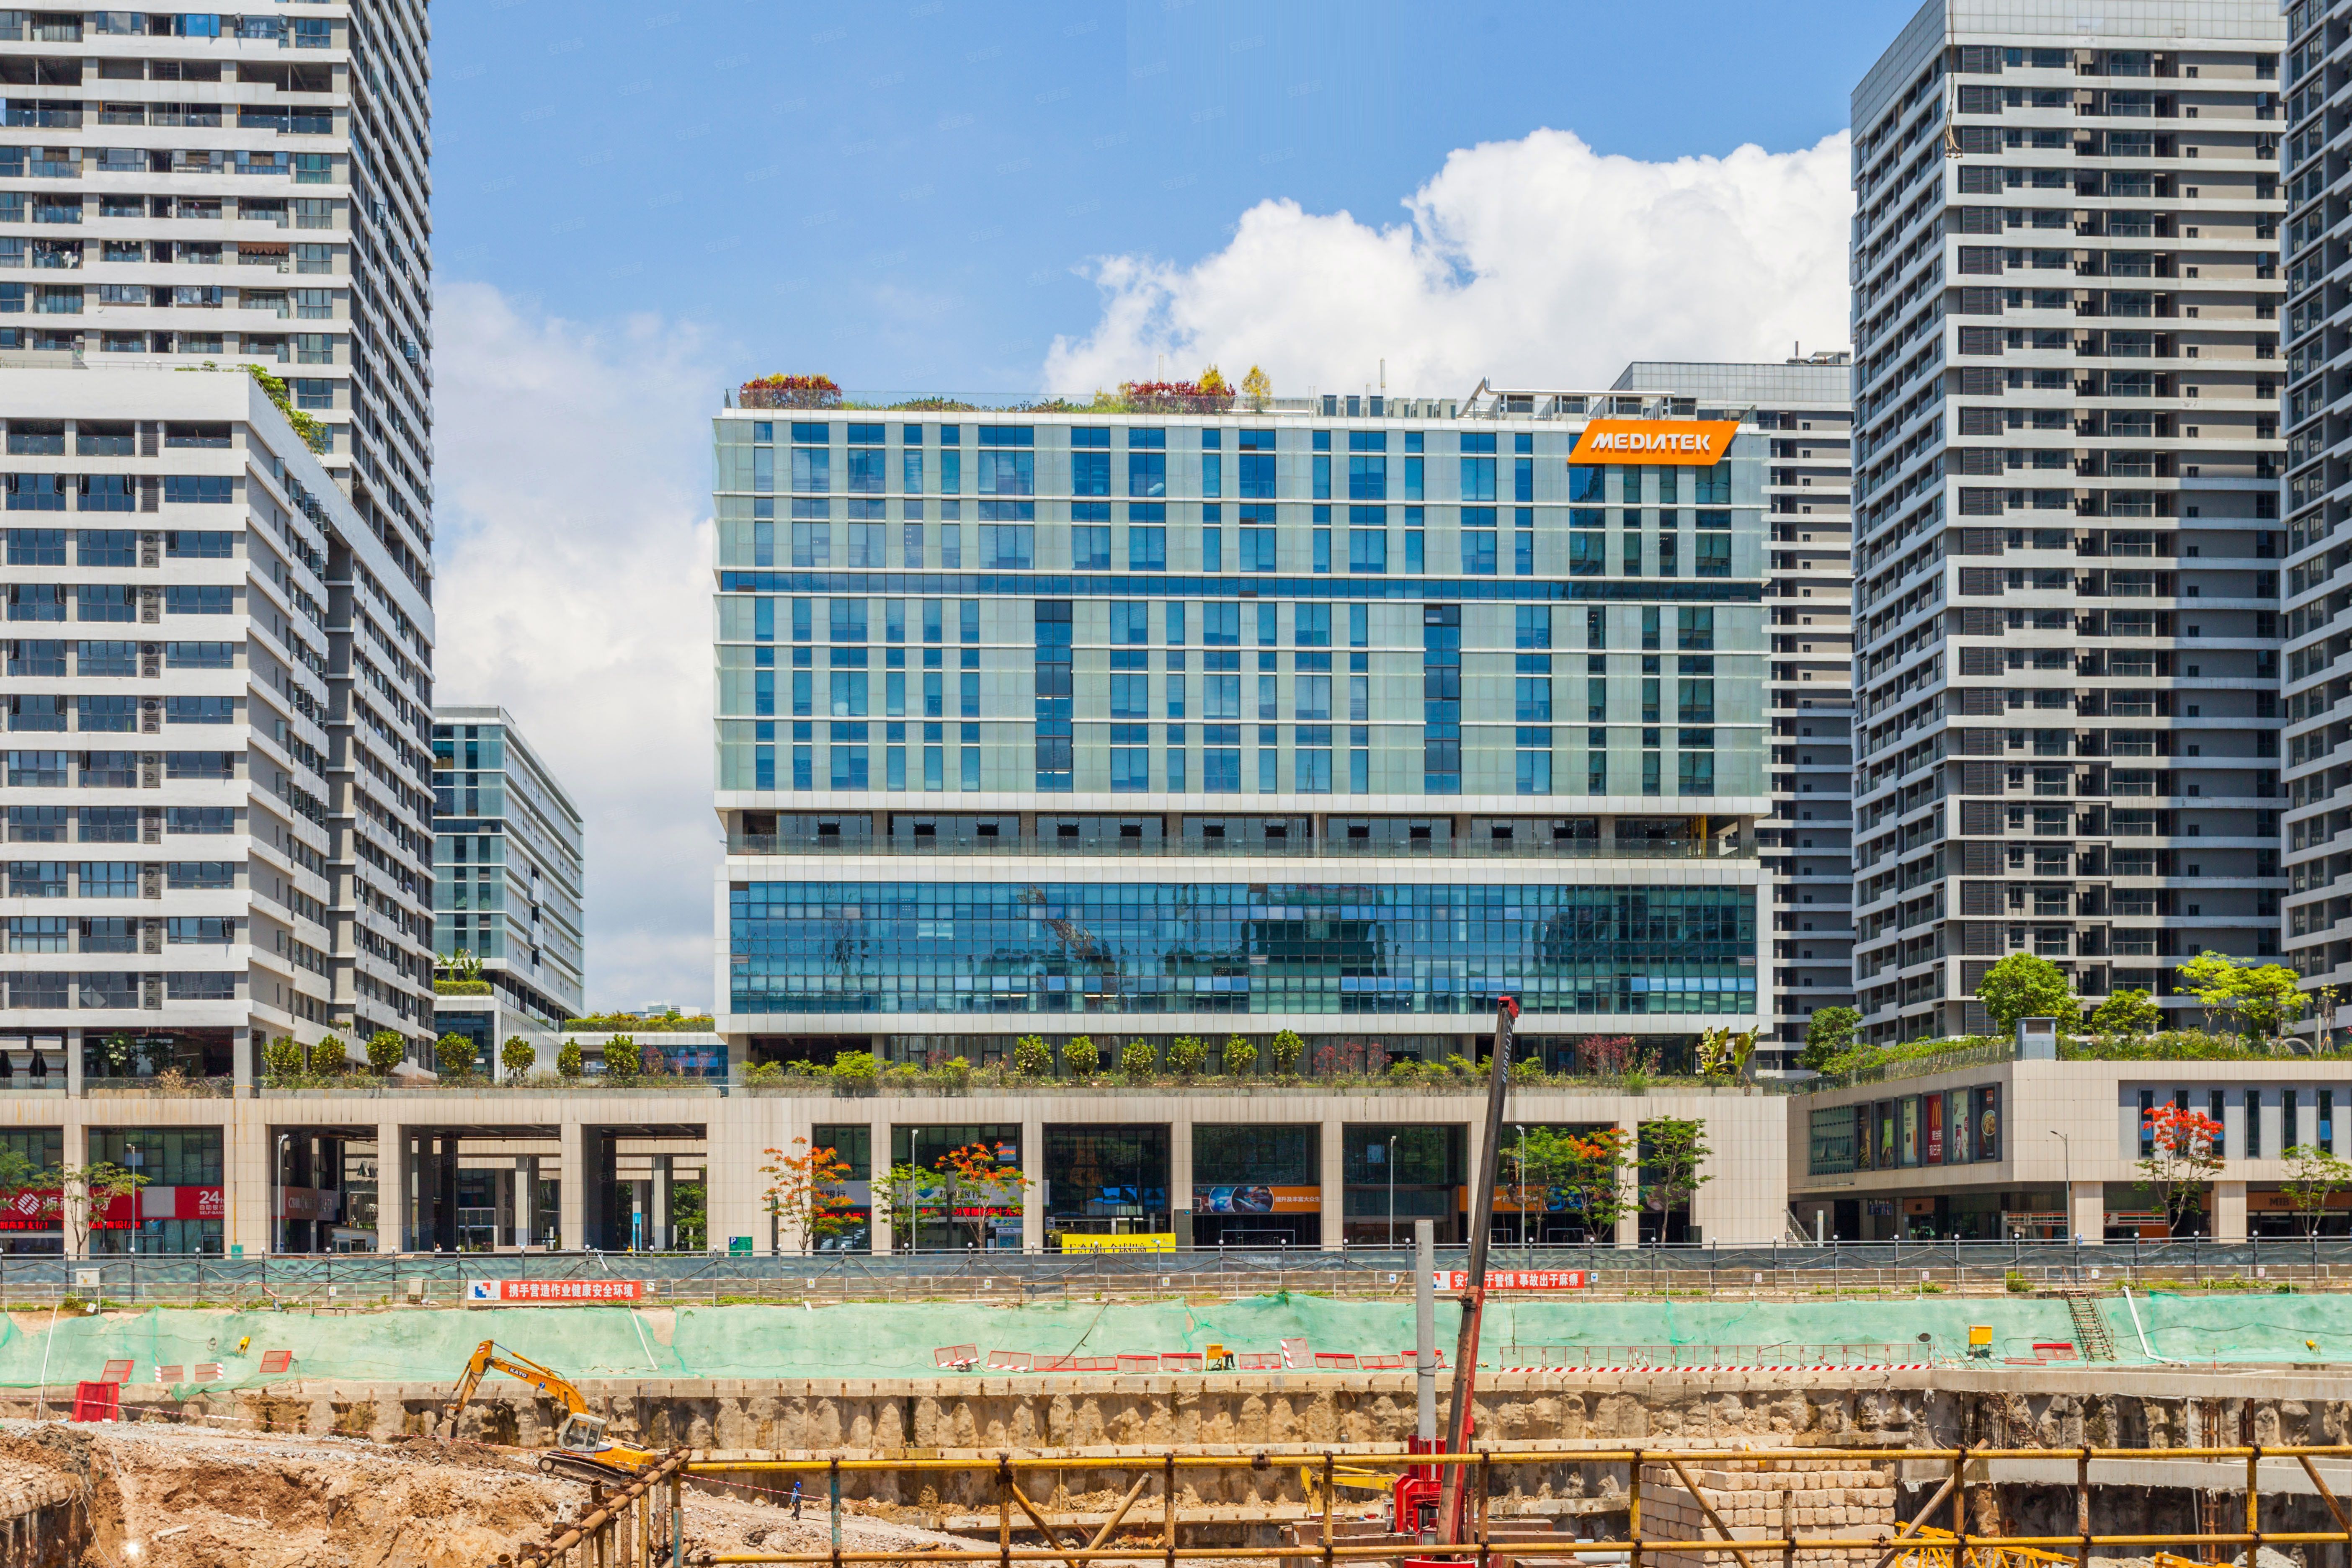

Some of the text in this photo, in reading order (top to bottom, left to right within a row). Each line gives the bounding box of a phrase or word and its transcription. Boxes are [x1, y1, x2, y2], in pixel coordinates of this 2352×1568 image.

[1591, 433, 1710, 450] MEDIATEK
[1455, 1274, 1514, 1287] 安于警惕
[509, 1283, 634, 1297] 携手营造作业健康安全环境
[509, 1368, 527, 1378] KATO
